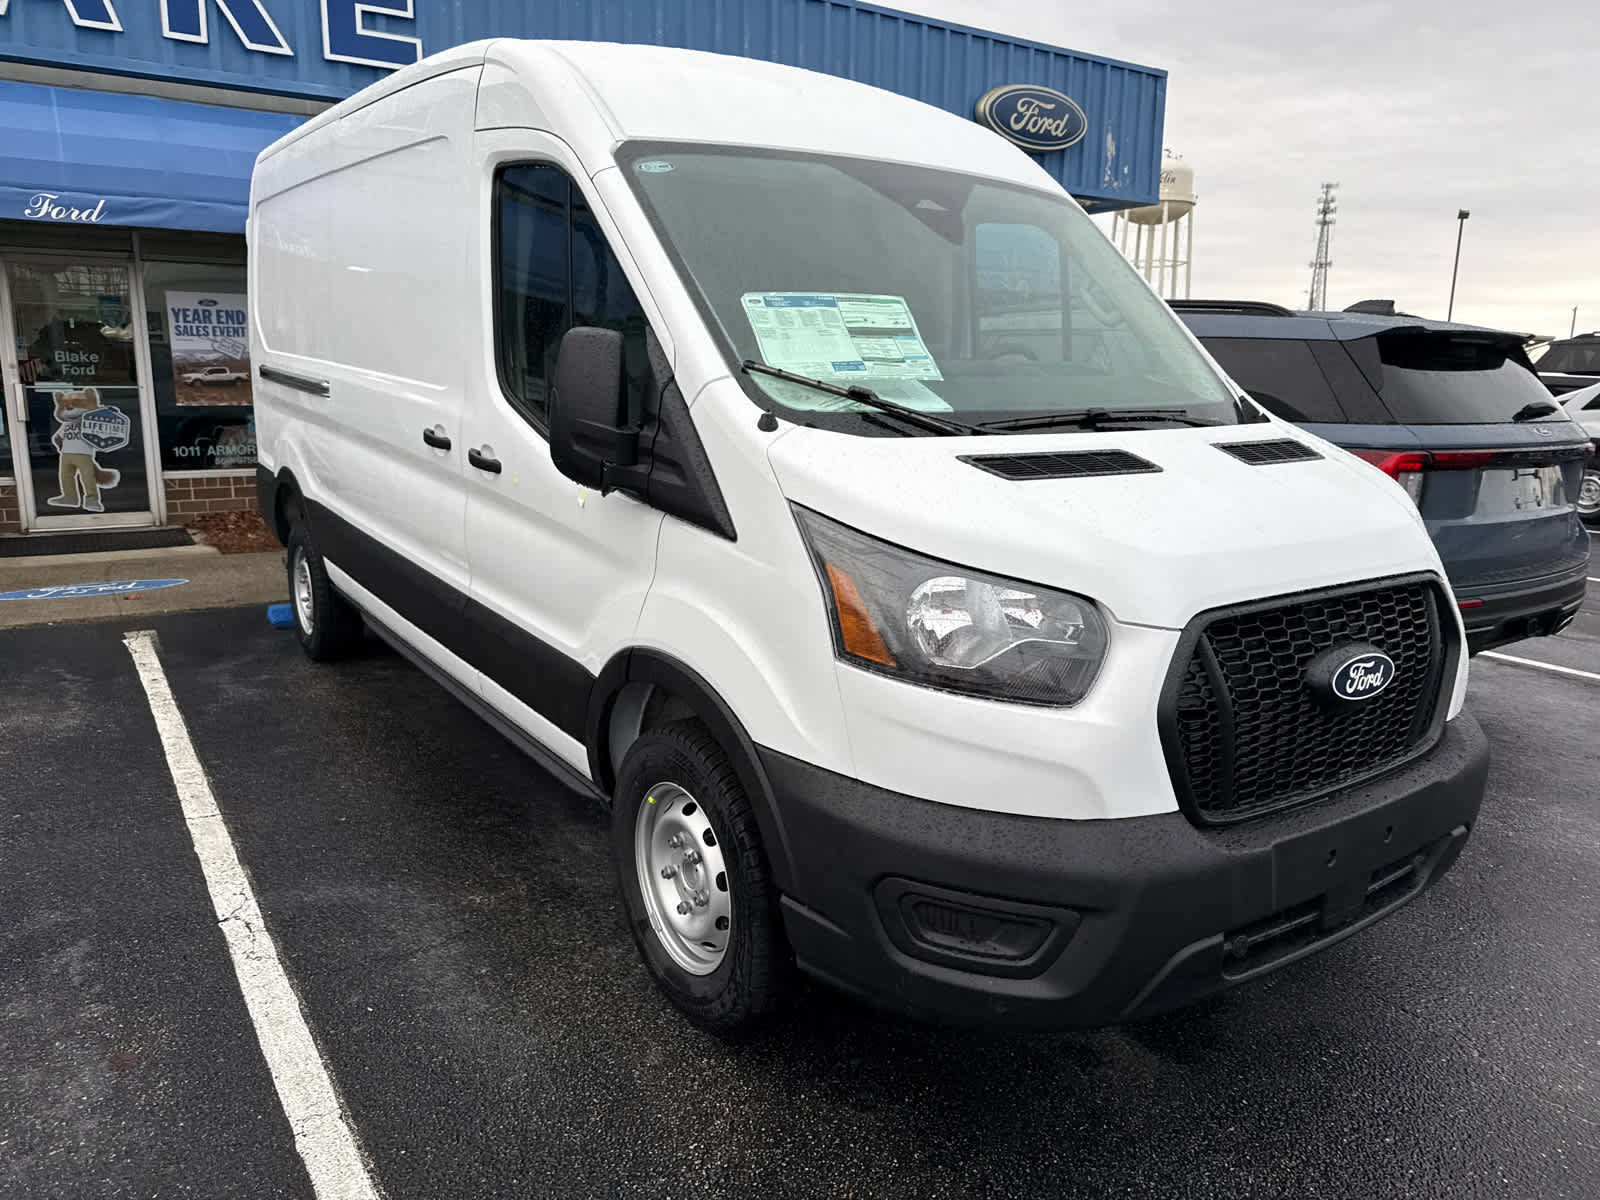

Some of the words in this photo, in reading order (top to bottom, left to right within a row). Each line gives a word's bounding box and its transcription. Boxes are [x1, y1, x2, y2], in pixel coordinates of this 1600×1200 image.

[1010, 97, 1069, 138] Ford
[24, 193, 109, 222] Ford
[171, 307, 213, 324] YEAR
[215, 309, 246, 325] END
[174, 324, 210, 337] SALES
[211, 325, 247, 338] EVENT
[54, 350, 99, 363] Blake
[62, 364, 96, 376] Ford
[172, 445, 201, 457] 1011
[1346, 661, 1384, 694] Ford
